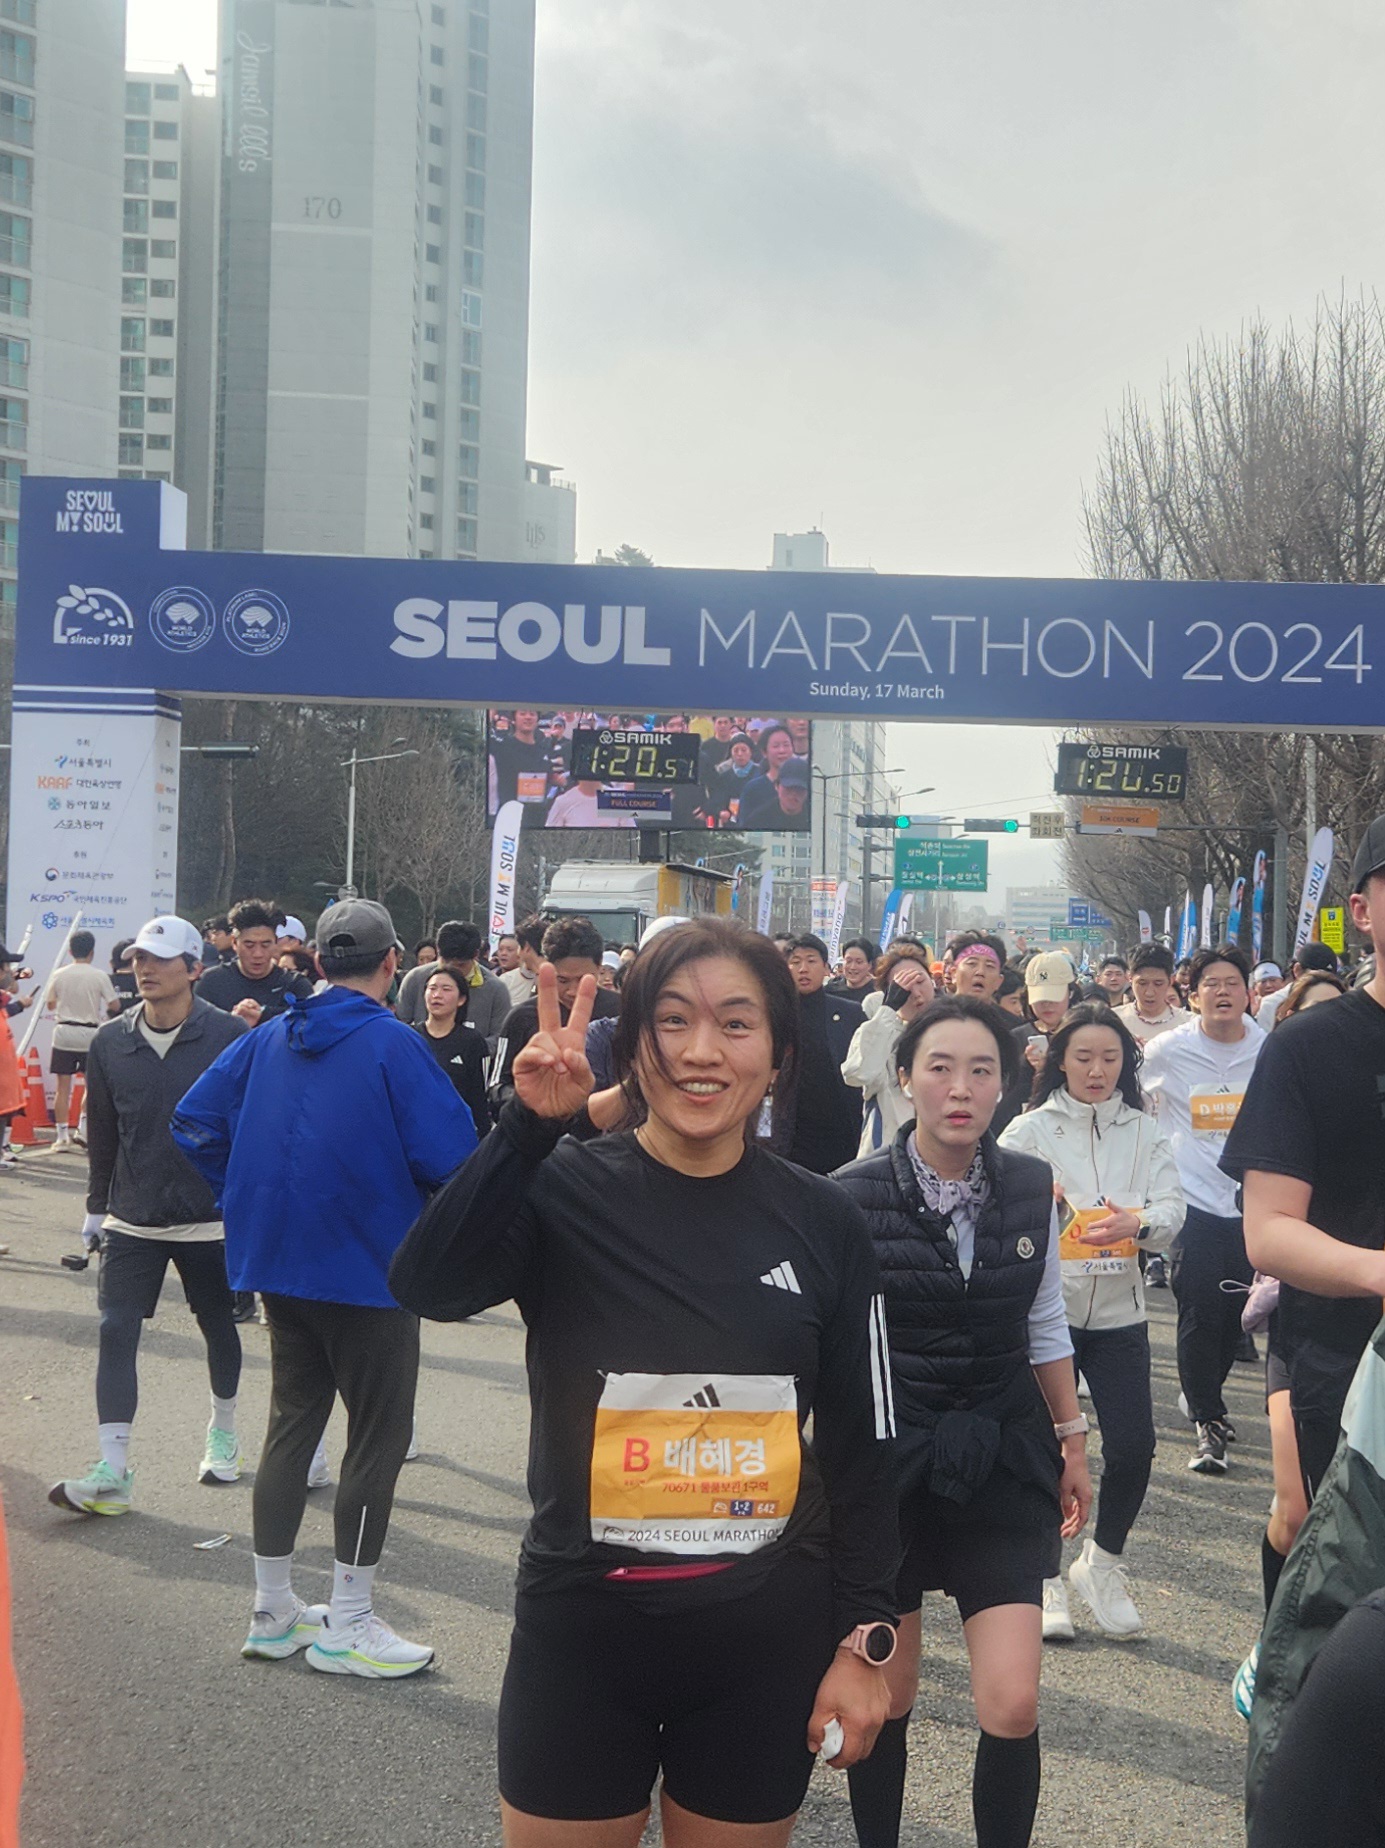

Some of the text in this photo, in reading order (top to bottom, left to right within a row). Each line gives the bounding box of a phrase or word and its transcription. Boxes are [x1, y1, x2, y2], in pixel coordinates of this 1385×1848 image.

[303, 197, 342, 219] 170
[83, 512, 124, 533] SOUL
[70, 634, 133, 647] since 1931
[389, 597, 1372, 684] SEOUL MARATHON 2024
[809, 681, 945, 700] Sunday, 17 March
[614, 731, 672, 745] SAMIK
[1102, 746, 1161, 760] SAMIK
[69, 758, 112, 768] 서울특별시
[37, 775, 73, 789] KAAF
[66, 799, 111, 811] 동아일보
[54, 819, 104, 830] 스포츠동아
[500, 835, 516, 872] SOUL
[30, 893, 65, 903] KSPO
[1199, 1103, 1210, 1116] D
[623, 1437, 767, 1477] B 배혜경
[662, 1482, 698, 1493] 70671
[757, 1502, 776, 1514] 642
[628, 1529, 660, 1542] 2024
[663, 1529, 710, 1542] SEOUL
